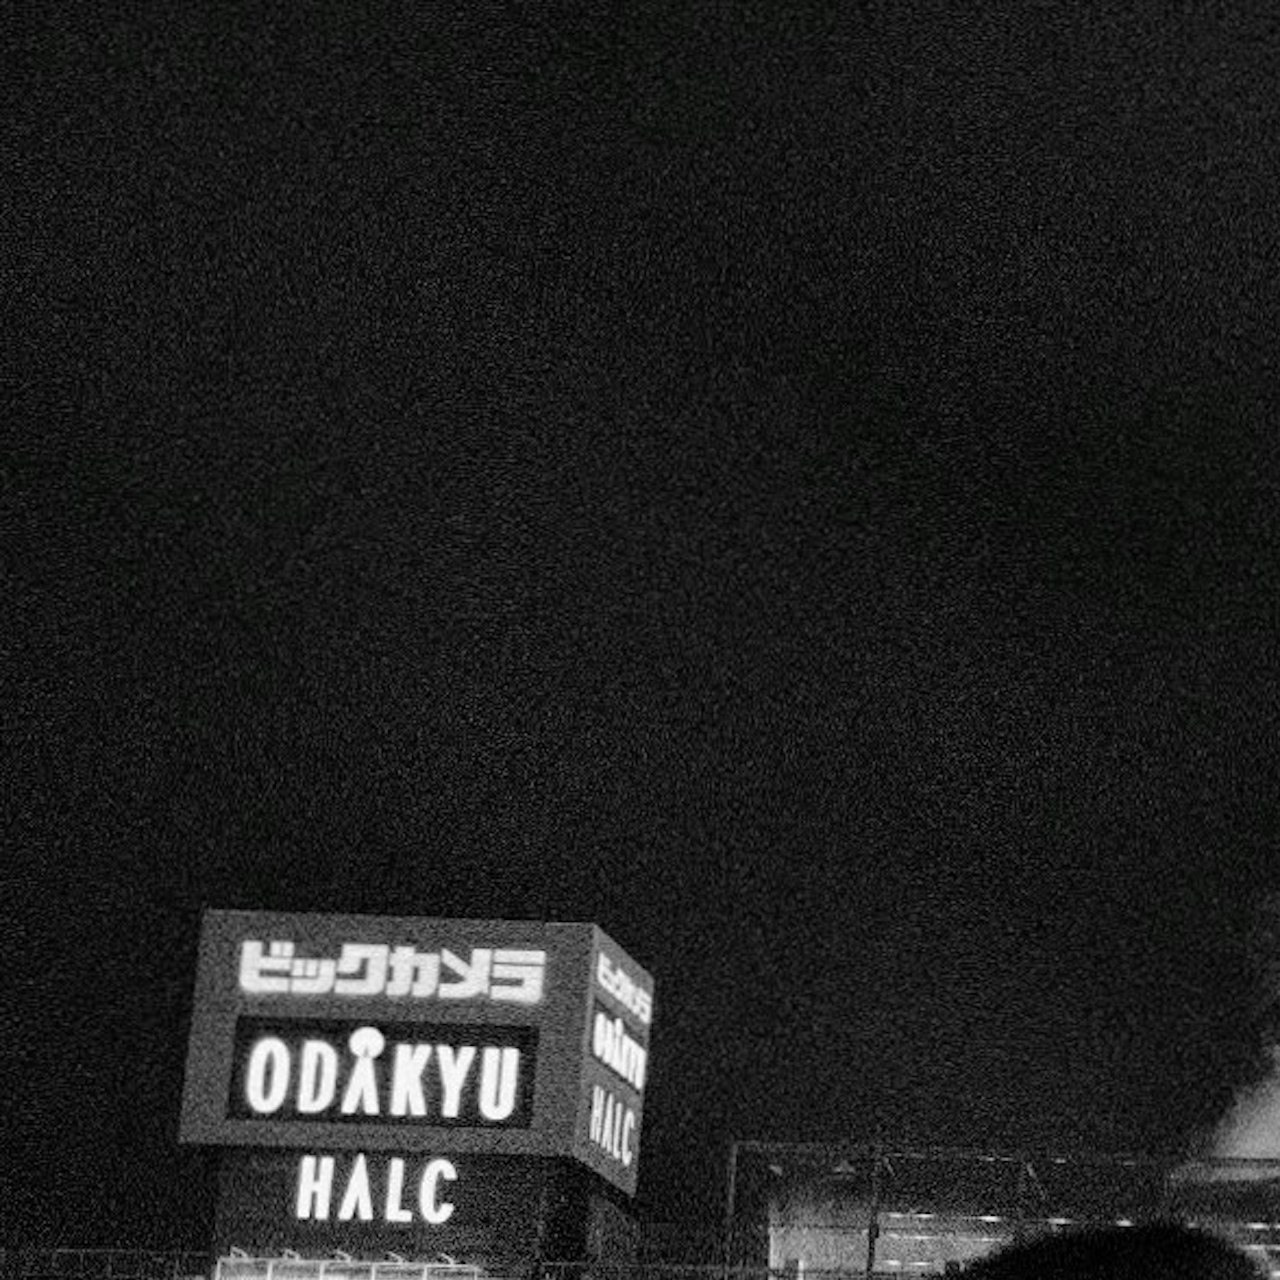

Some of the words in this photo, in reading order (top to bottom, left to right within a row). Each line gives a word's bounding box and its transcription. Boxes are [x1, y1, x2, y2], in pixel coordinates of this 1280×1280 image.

[239, 940, 546, 1004] ビックカメラ
[245, 1026, 520, 1120] ODAKYU
[590, 1085, 635, 1166] HALC
[296, 1153, 458, 1225] HALC
